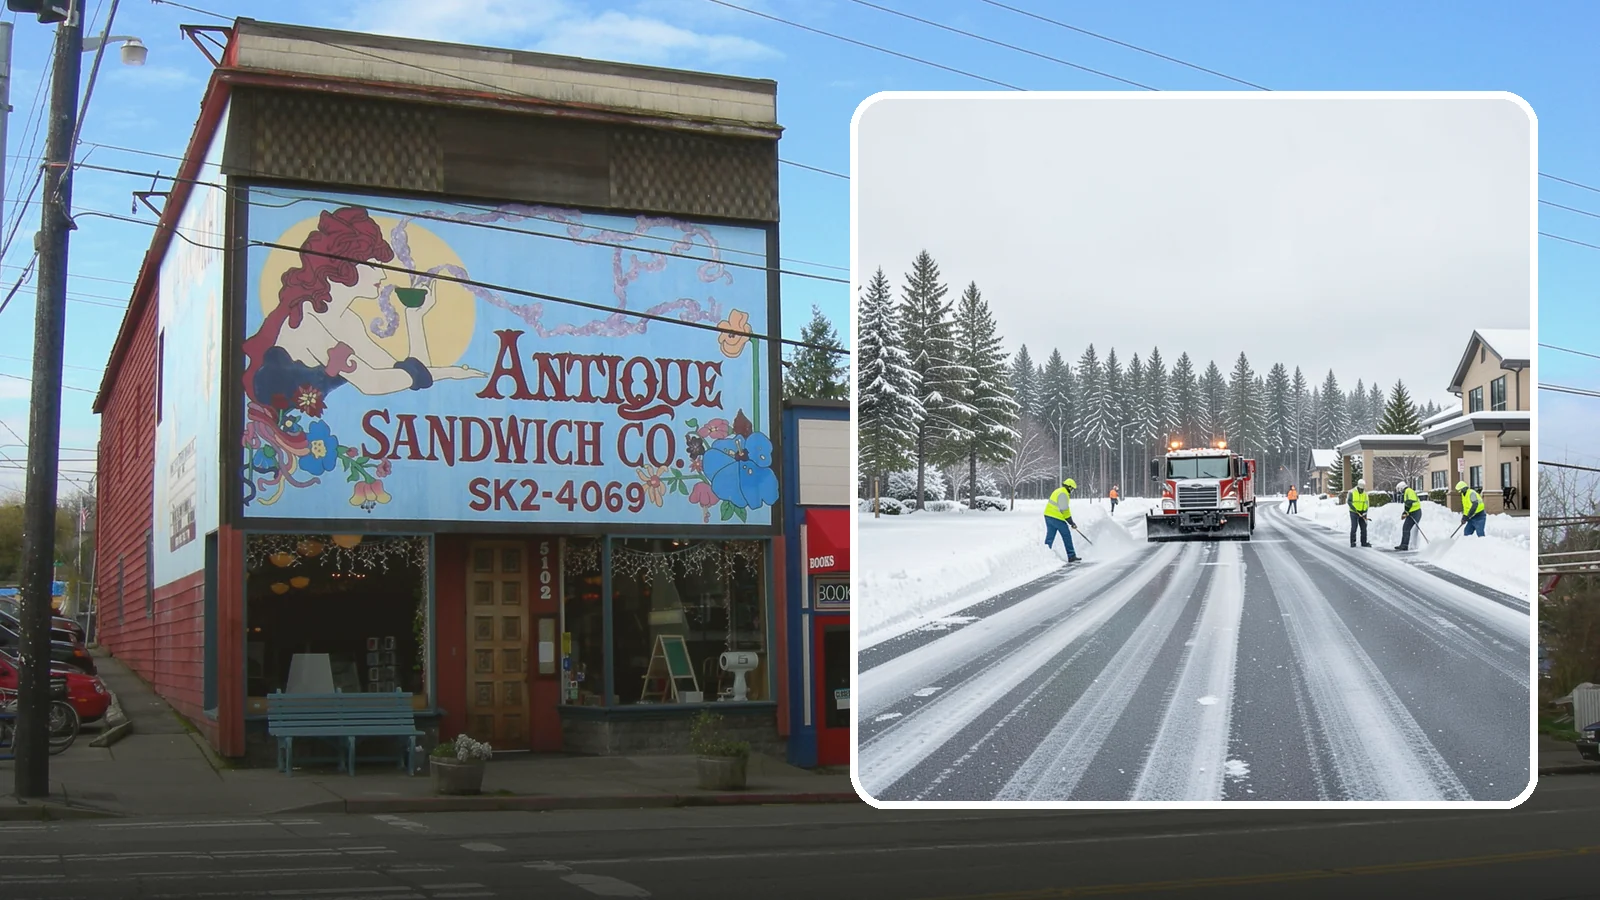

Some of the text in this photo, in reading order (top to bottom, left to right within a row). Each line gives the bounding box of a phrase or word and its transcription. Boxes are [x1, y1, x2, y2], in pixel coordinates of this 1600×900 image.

[477, 330, 723, 421] ANTIQUE
[362, 409, 685, 469] SANDWICH CO.
[469, 478, 645, 513] SK2-4069
[540, 542, 551, 599] 5102
[810, 555, 835, 569] BOOKS
